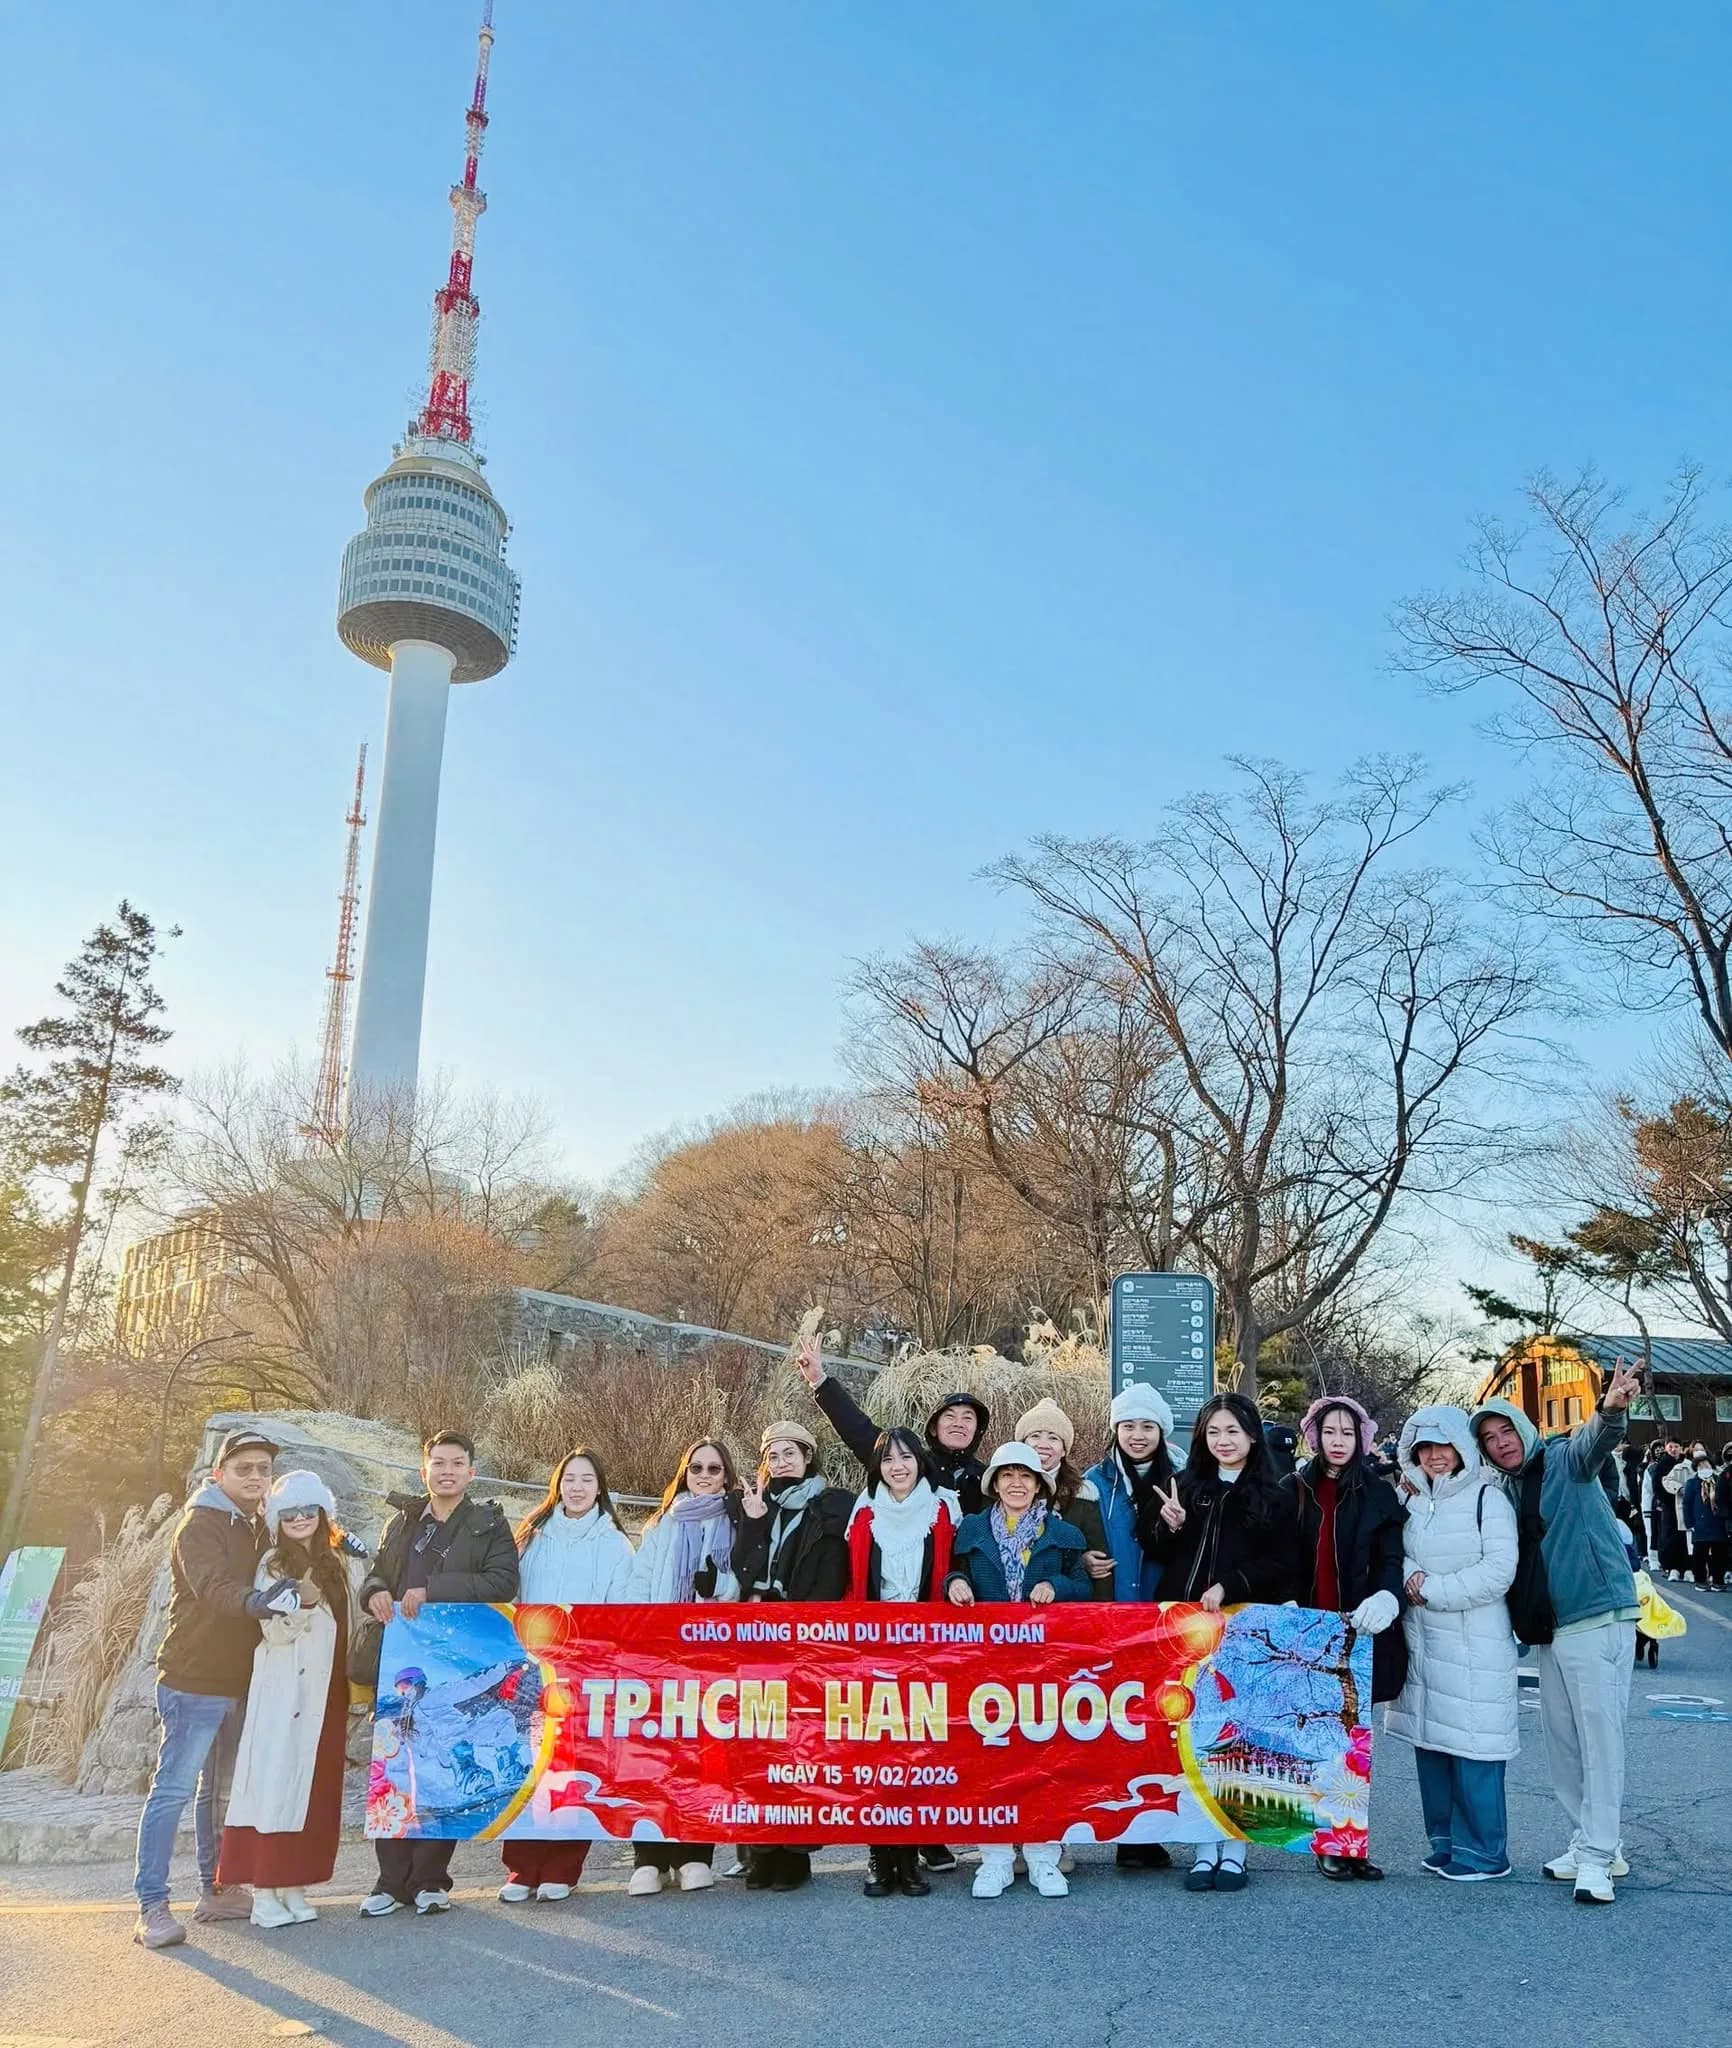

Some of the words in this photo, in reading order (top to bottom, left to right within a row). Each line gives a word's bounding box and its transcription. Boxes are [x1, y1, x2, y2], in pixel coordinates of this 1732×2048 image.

[680, 1619, 731, 1642] CHÀO
[736, 1619, 791, 1642] MỪNG
[796, 1619, 849, 1642] ĐOÀN
[854, 1622, 881, 1642] DU
[886, 1623, 925, 1644] LỊCH
[930, 1623, 984, 1643] THAM
[989, 1623, 1045, 1645] QUAN
[968, 1660, 1147, 1747] QUỐC
[707, 1800, 760, 1825] #LIÊN
[764, 1805, 813, 1825] MINH
[818, 1803, 855, 1826] CÁC
[859, 1803, 913, 1826] CÔNG
[917, 1806, 941, 1826] TY
[946, 1807, 973, 1826] DU
[978, 1805, 1019, 1828] LỊCH
